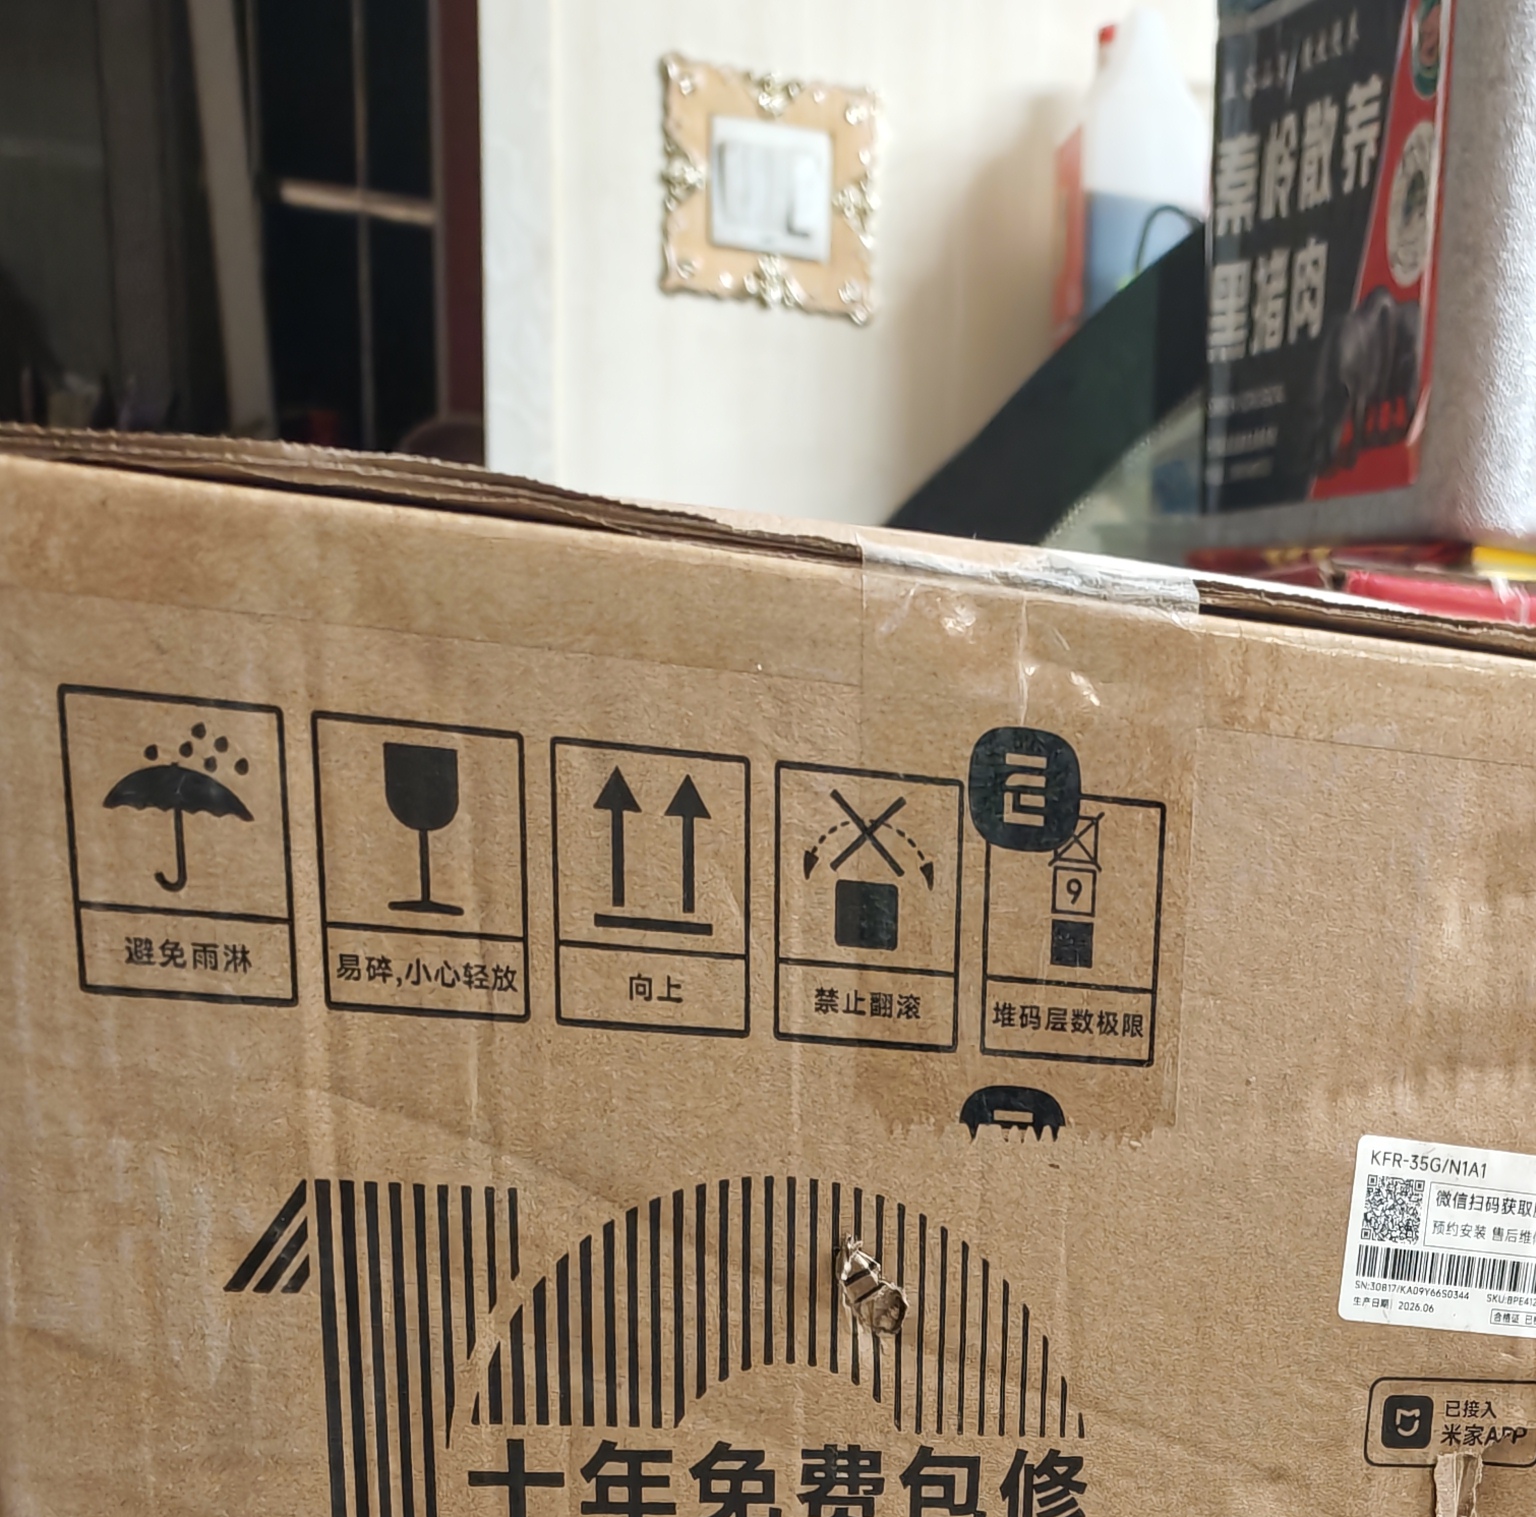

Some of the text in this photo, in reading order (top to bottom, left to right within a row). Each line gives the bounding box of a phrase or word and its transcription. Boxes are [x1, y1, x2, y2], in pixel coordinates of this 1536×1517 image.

[1207, 237, 1328, 363] 黑猪肉
[1066, 876, 1083, 906] 9
[124, 936, 254, 975] 避免雨淋
[628, 972, 684, 1004] 向上
[814, 986, 922, 1021] 禁止翻滚
[992, 1001, 1145, 1040] 堆码层数极限
[1370, 1149, 1488, 1179] KFR-35G/N1A1
[1432, 1219, 1487, 1241] 预约安装
[1397, 1300, 1435, 1314] 2026.06
[1445, 1398, 1498, 1419] 已接入
[1440, 1422, 1529, 1448] 米家APP
